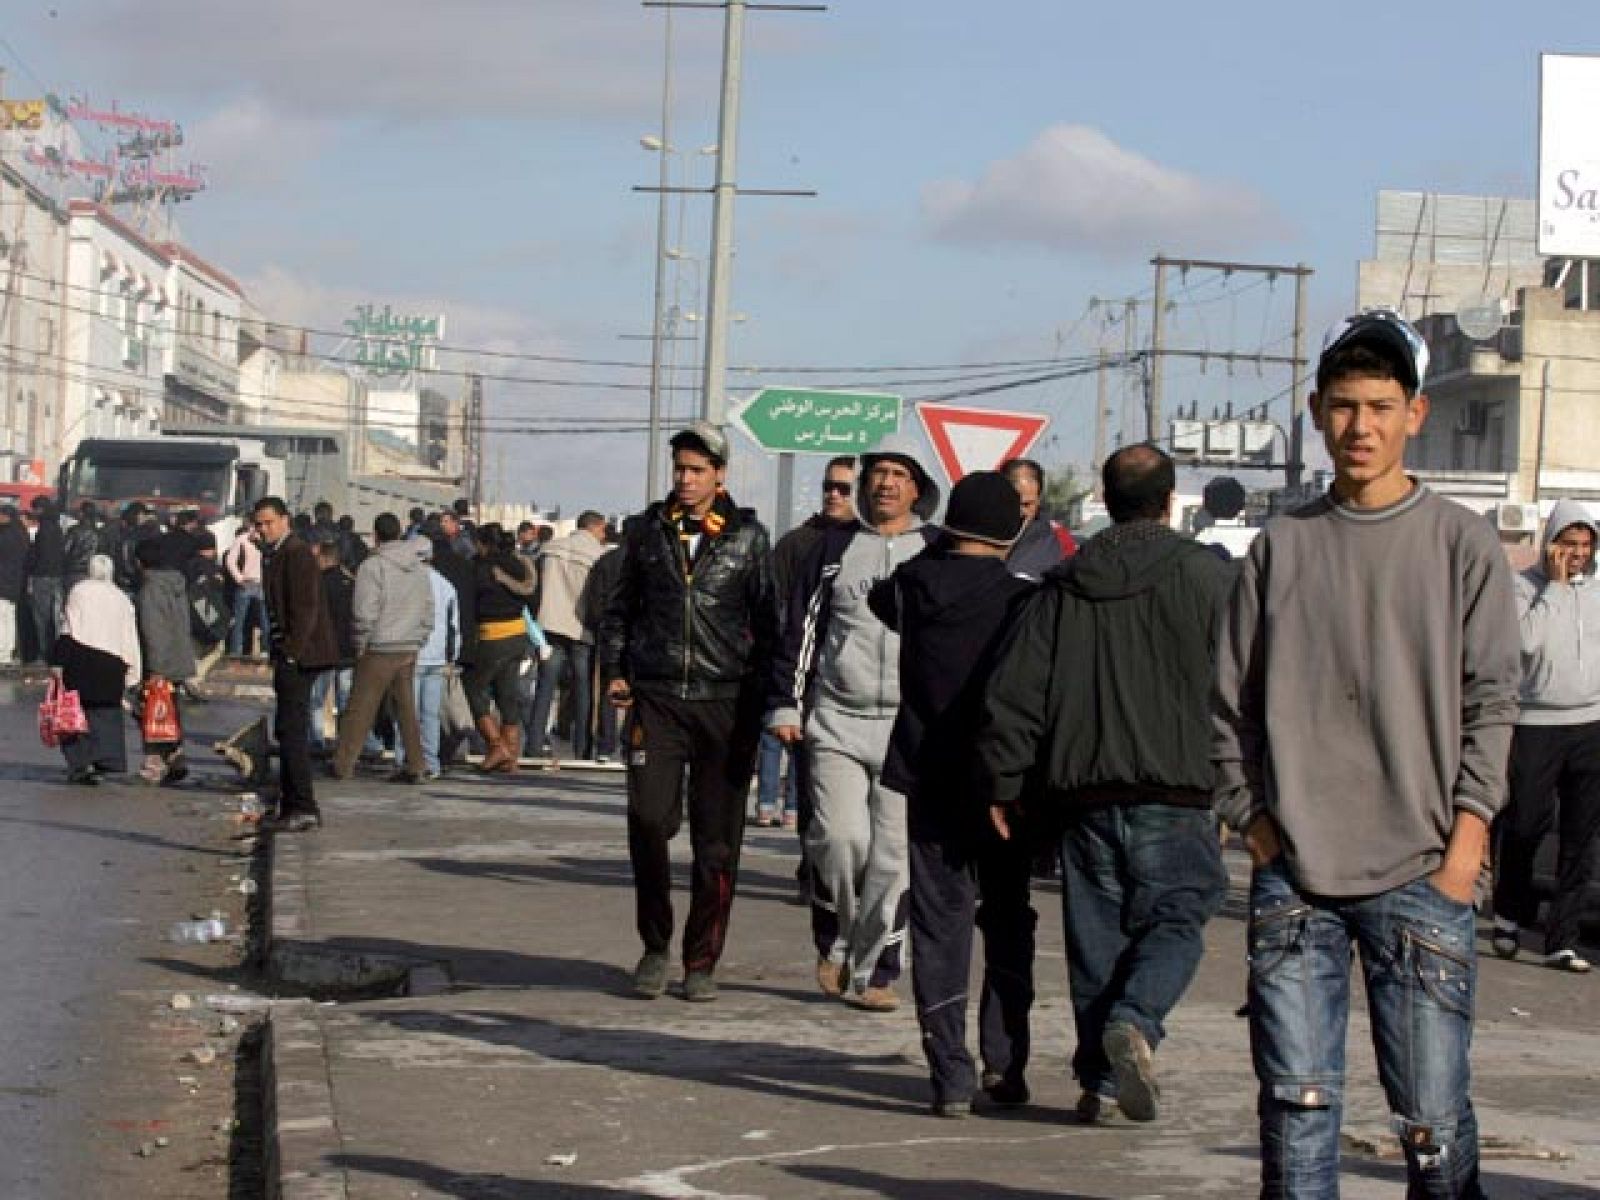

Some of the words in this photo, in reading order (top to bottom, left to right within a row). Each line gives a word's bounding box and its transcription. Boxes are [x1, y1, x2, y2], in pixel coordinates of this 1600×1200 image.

[768, 398, 814, 421] الوطني
[814, 401, 862, 421] الحرس
[863, 402, 896, 423] مركز
